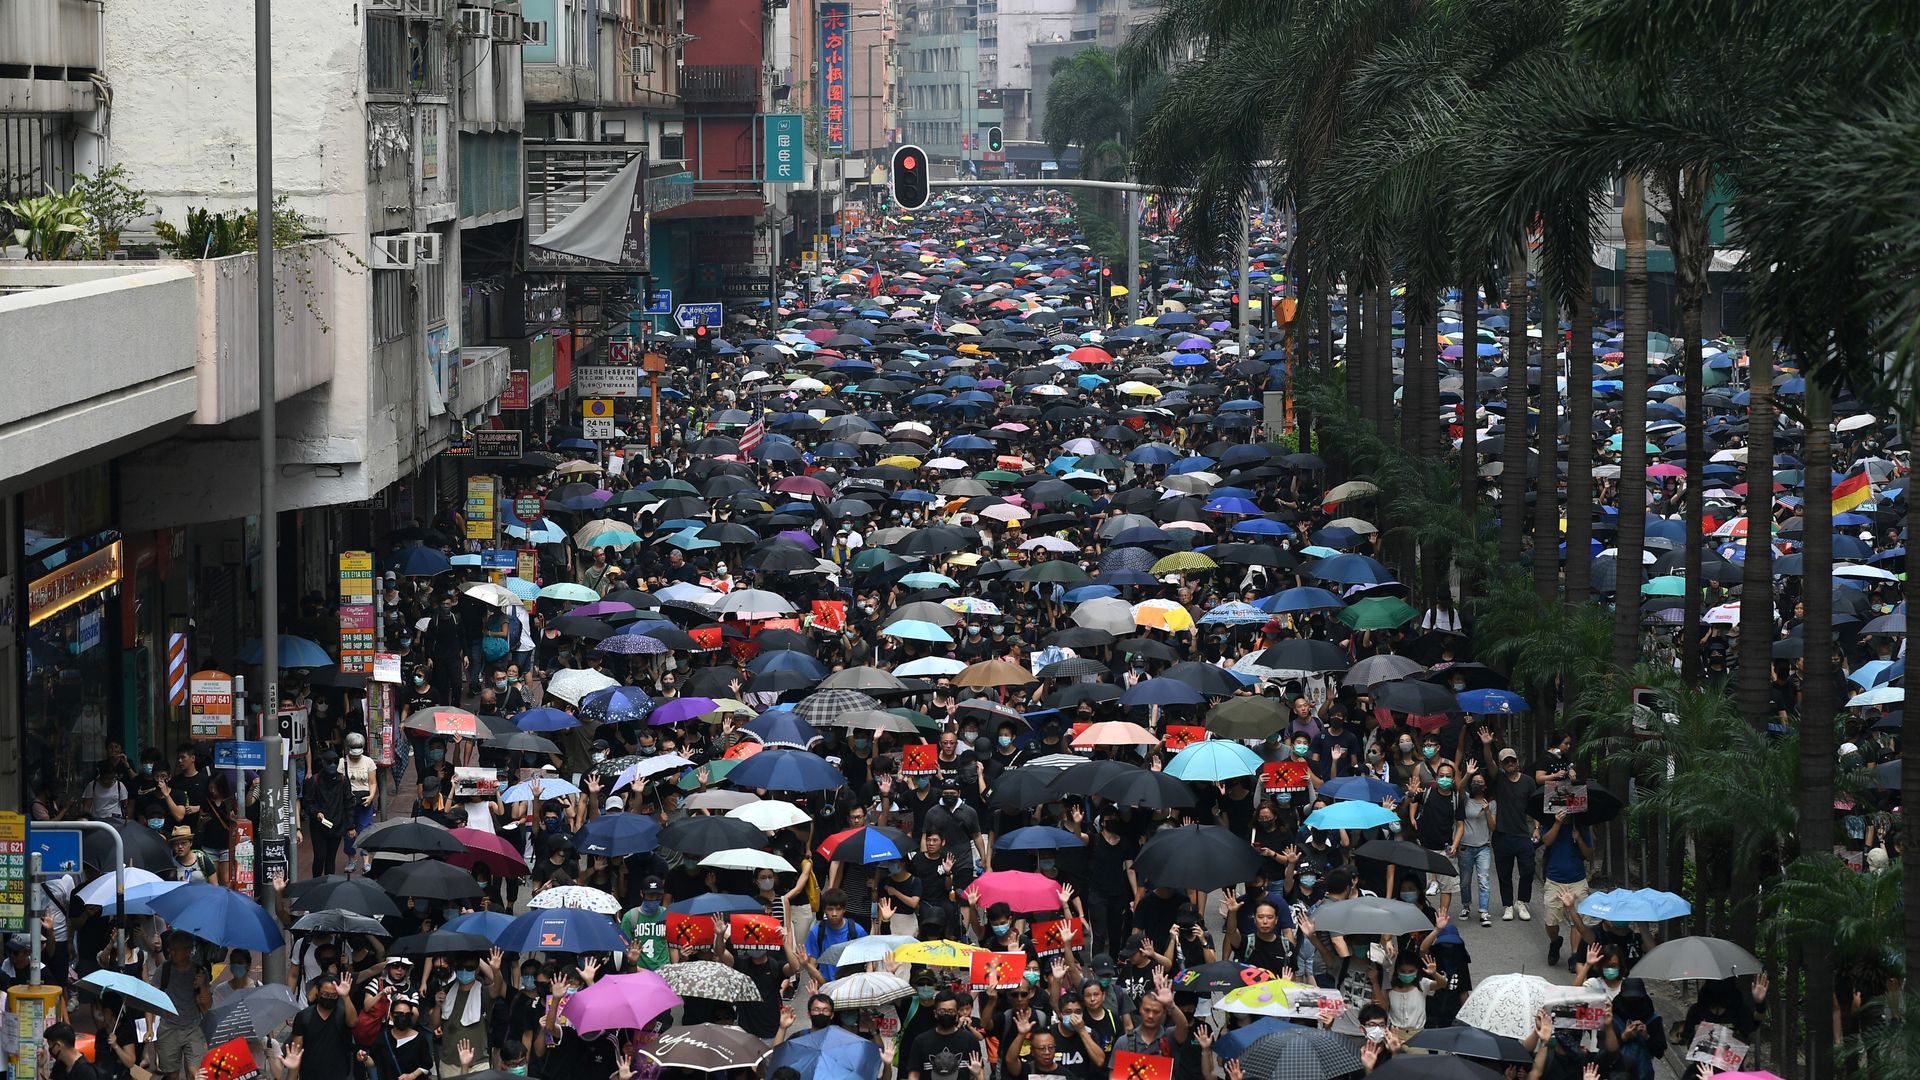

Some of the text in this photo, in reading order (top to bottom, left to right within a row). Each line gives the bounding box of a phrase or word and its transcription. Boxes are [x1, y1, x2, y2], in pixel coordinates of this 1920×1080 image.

[778, 134, 791, 177] 屈臣氏
[589, 428, 608, 438] 全日
[192, 695, 204, 703] 601
[218, 695, 230, 703] 641
[10, 843, 23, 853] 621
[9, 855, 24, 865] 962B
[9, 867, 24, 877] 962X
[634, 922, 667, 937] BOSTON
[642, 939, 655, 959] 4
[1575, 1007, 1605, 1021] CCP
[1053, 1051, 1084, 1065] FILA
